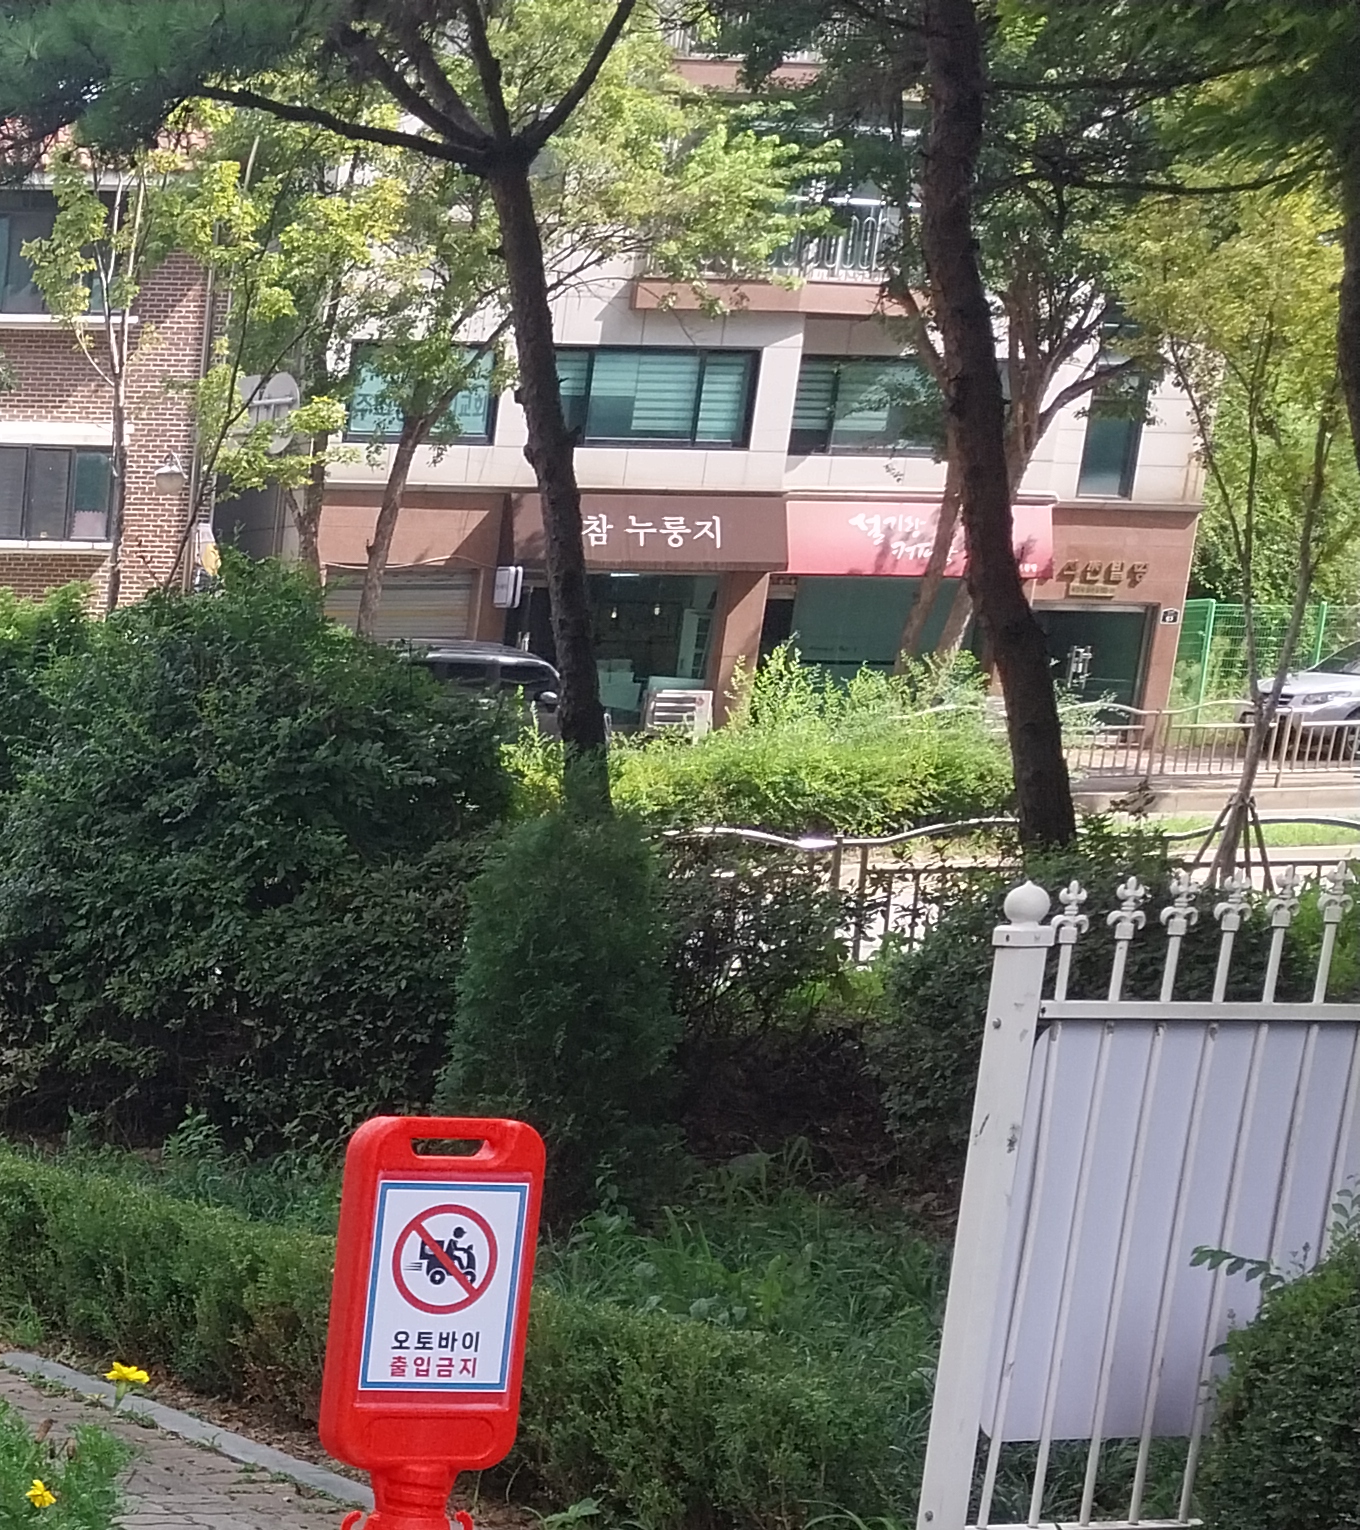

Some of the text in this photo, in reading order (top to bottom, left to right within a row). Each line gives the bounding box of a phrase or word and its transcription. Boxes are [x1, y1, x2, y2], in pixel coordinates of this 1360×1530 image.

[581, 513, 722, 549] 참 누룽지
[390, 1330, 481, 1353] 오토바이
[388, 1355, 478, 1379] 출입금지
